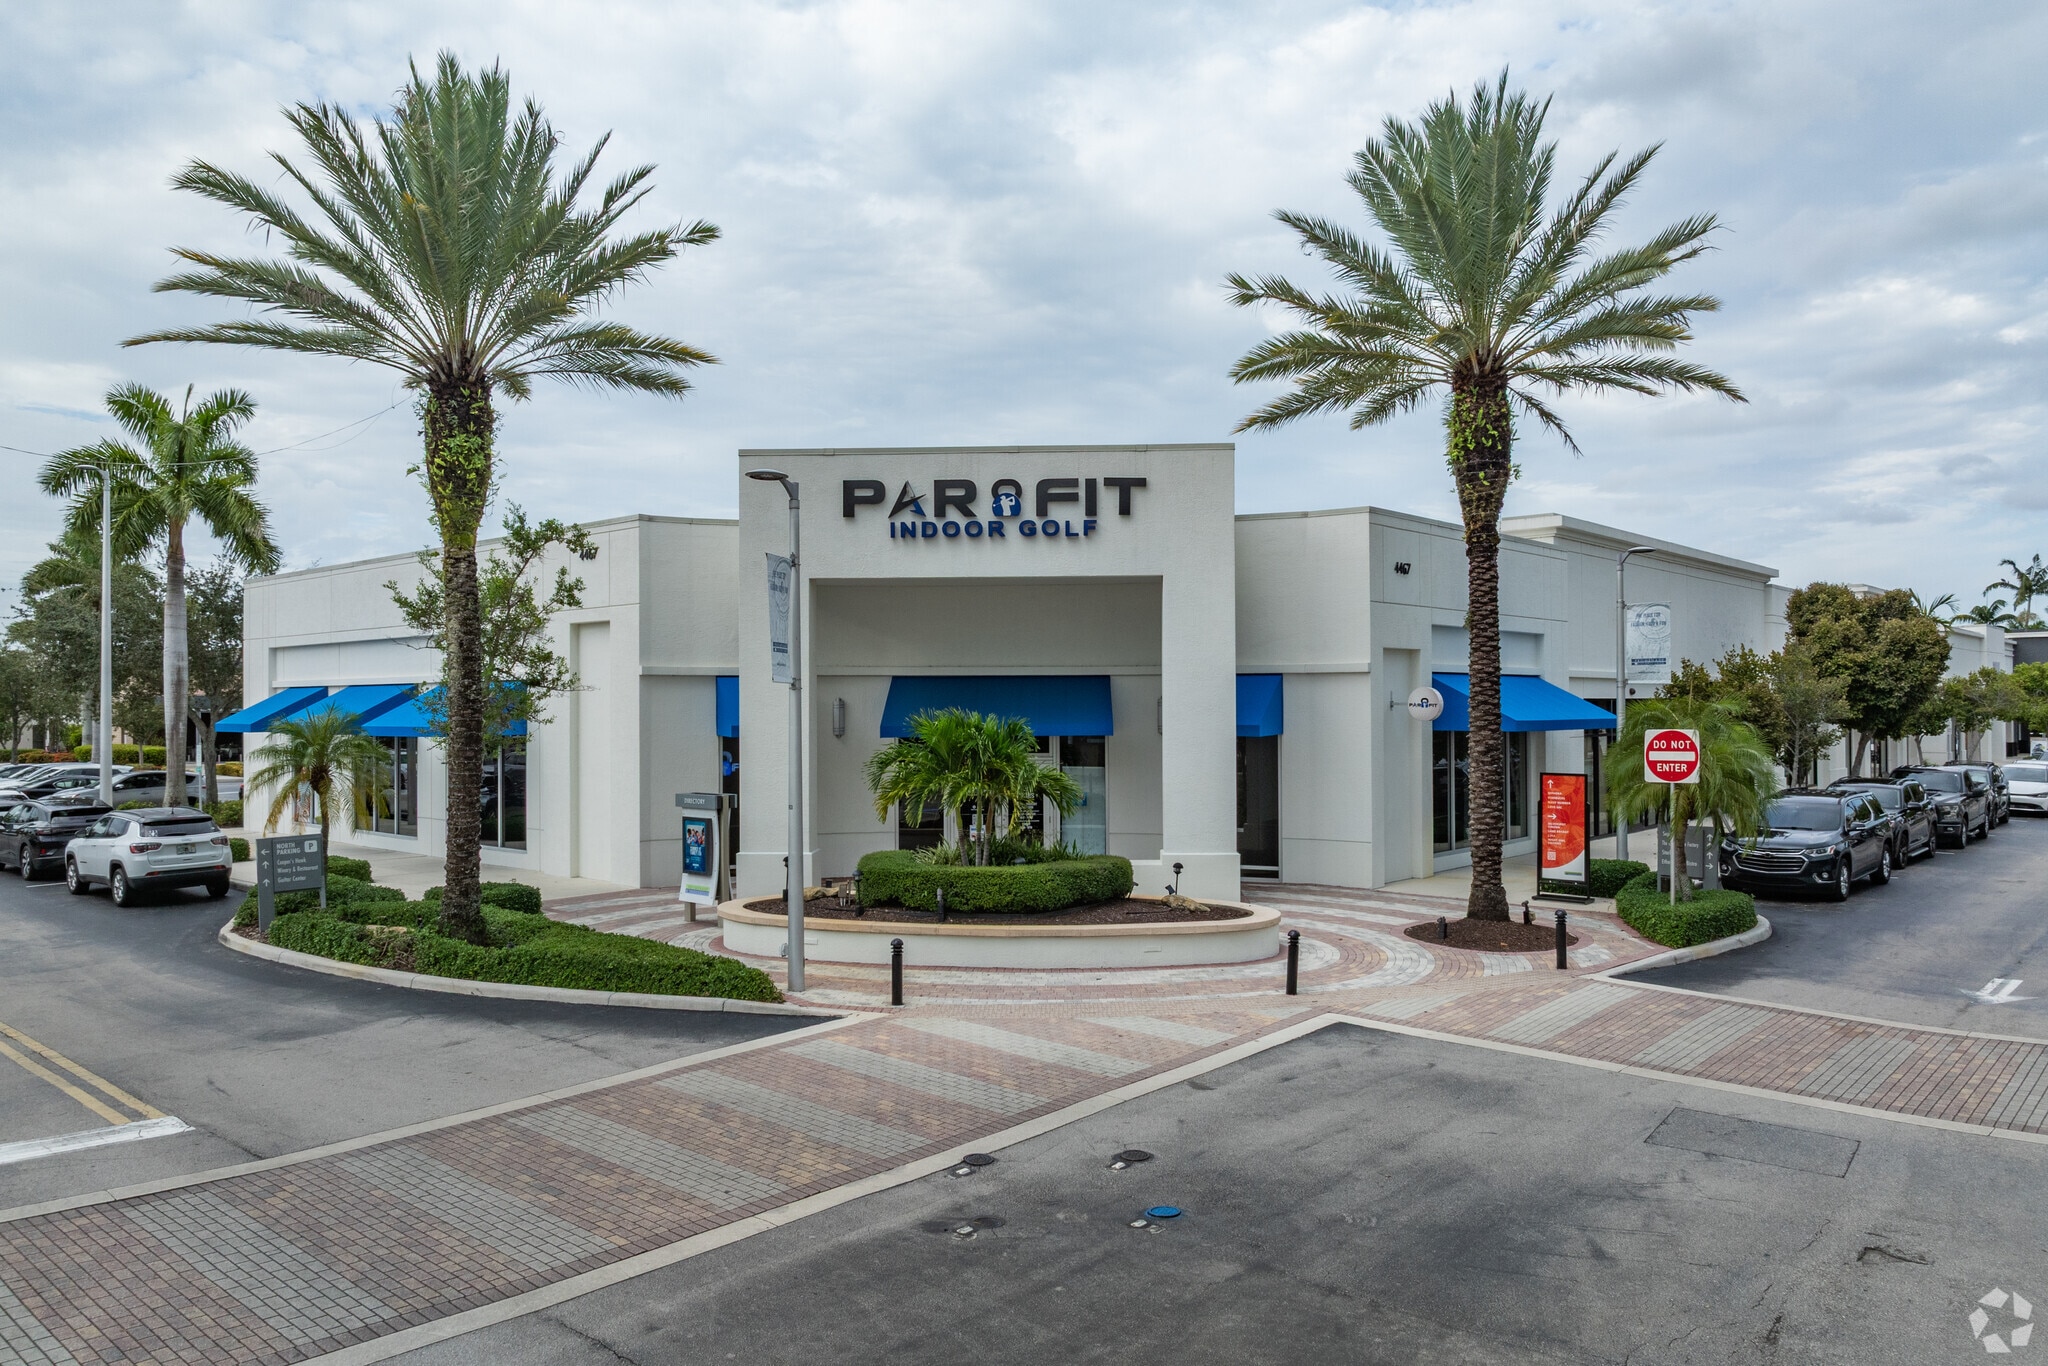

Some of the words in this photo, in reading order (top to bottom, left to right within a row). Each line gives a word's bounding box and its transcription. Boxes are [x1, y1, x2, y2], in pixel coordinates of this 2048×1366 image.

[889, 520, 1006, 538] INDOOR
[1018, 519, 1097, 537] GOLF
[1394, 562, 1411, 575] 4467
[1653, 740, 1667, 749] DO
[1671, 740, 1691, 749] NOT
[1657, 763, 1687, 772] ENTER
[276, 847, 301, 855] PARKING
